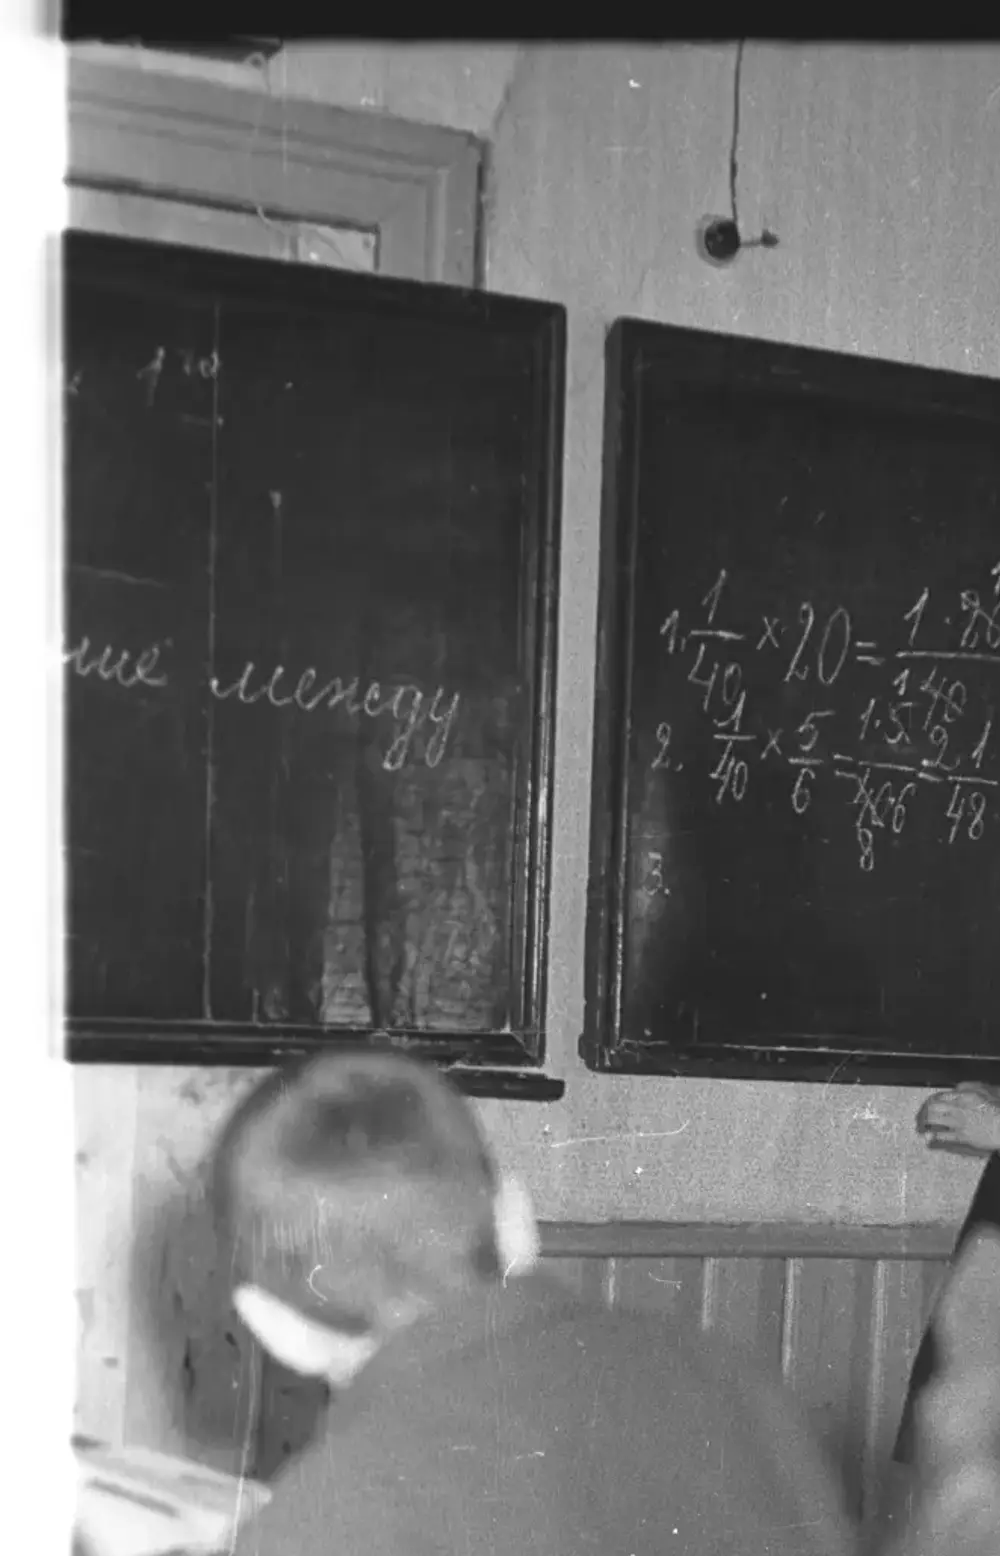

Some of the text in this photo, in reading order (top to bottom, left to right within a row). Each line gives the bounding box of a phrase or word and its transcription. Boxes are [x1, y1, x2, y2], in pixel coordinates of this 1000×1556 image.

[783, 600, 851, 686] 20
[210, 661, 460, 771] между
[946, 783, 987, 846] 48
